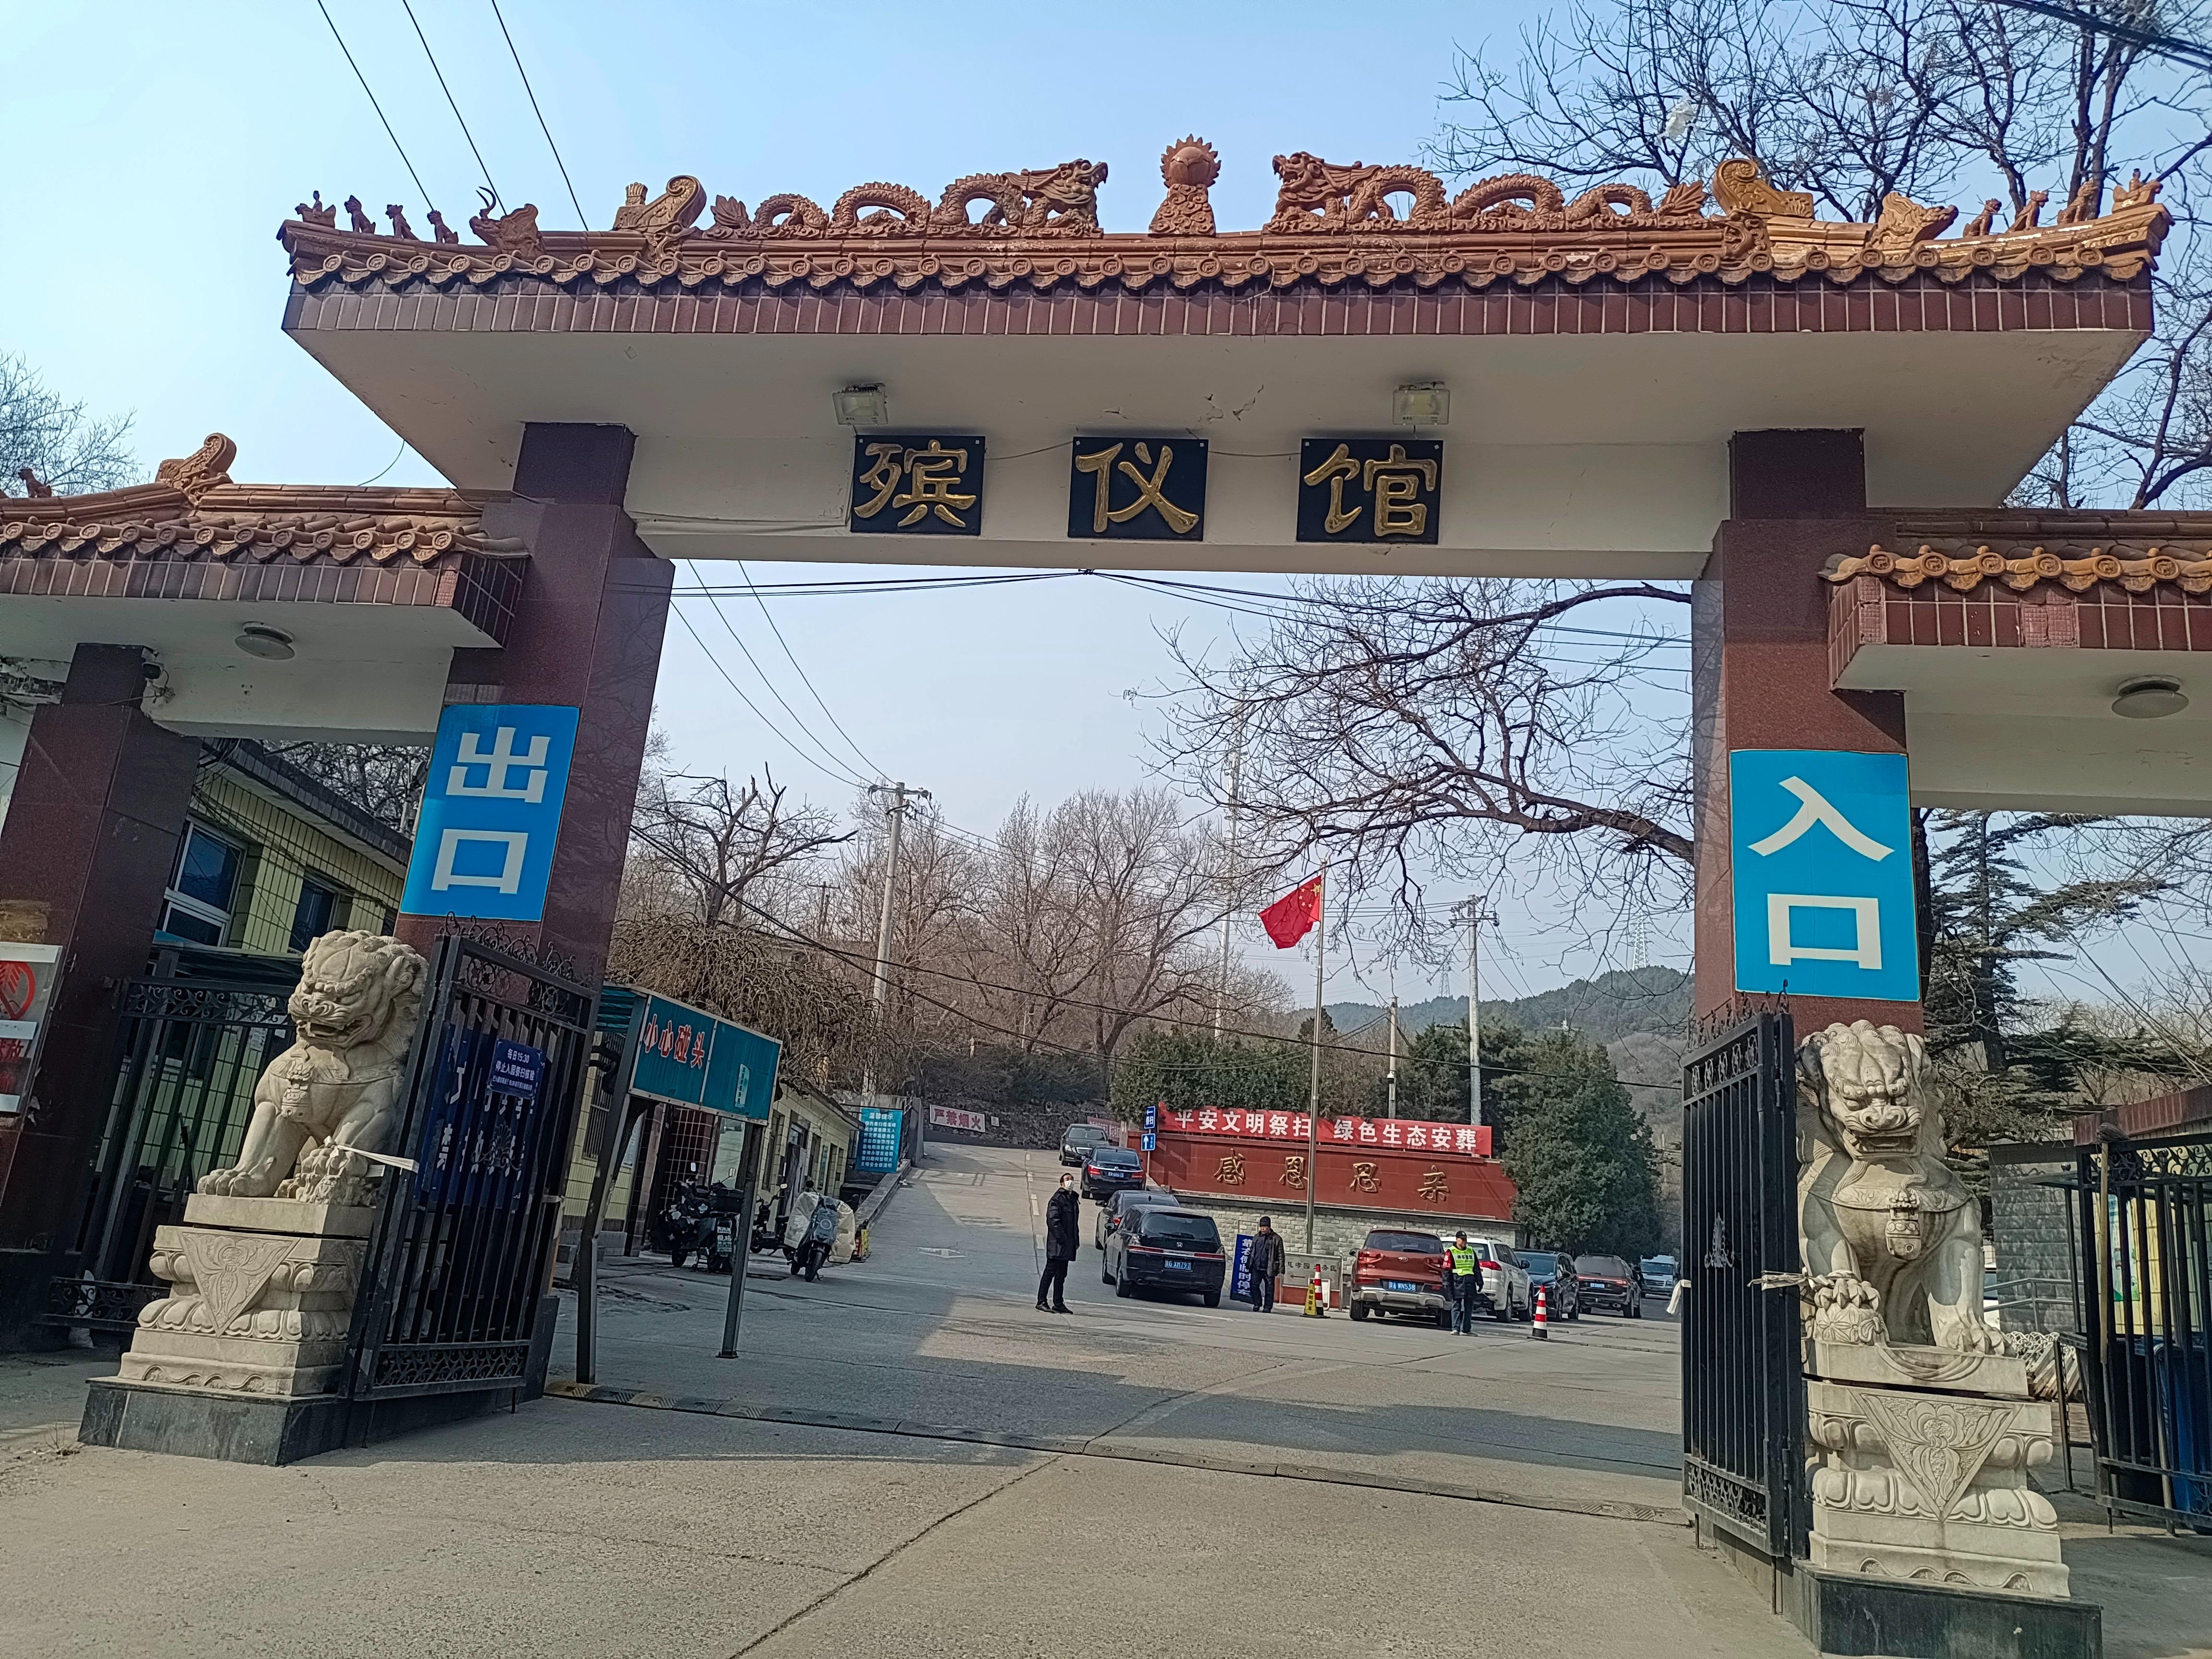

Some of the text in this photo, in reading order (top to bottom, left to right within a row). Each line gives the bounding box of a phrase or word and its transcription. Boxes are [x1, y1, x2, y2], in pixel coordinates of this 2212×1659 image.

[854, 440, 1437, 537] 殡仪馆
[431, 727, 551, 894] 出口
[1747, 776, 1895, 970] 入口
[507, 1048, 529, 1063] 每日15:30
[643, 1013, 705, 1070] 小心碰头
[495, 1060, 535, 1081] 停止入园祭扫核验
[934, 1108, 981, 1130] 严禁烟火
[1175, 1109, 1477, 1151] 平安文明祭扫 绿色生态安葬
